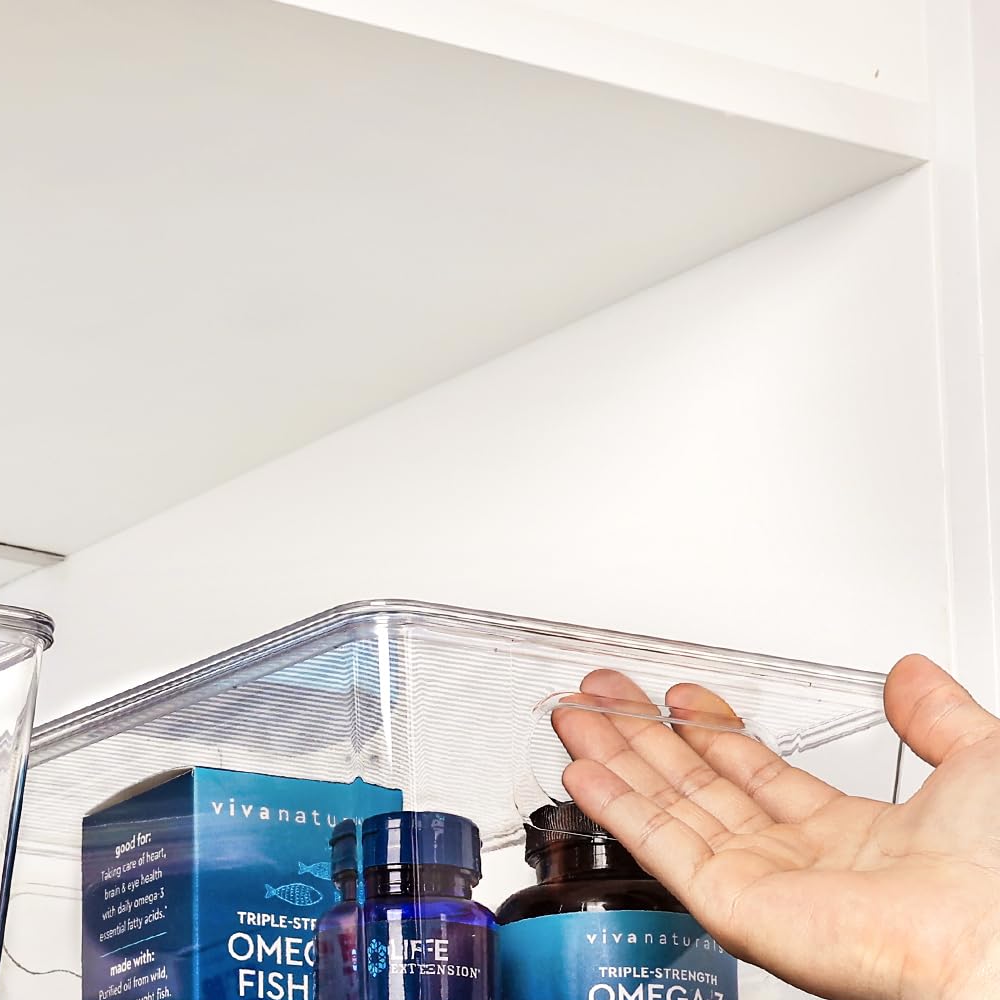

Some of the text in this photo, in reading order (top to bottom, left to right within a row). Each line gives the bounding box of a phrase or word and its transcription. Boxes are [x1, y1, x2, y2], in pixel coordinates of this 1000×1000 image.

[115, 832, 152, 858] good for:
[100, 848, 167, 882] Taking care of heart,
[104, 886, 120, 900] brain
[128, 879, 140, 894] eye
[140, 870, 163, 886] health
[102, 887, 165, 921] with daily omega-3
[100, 914, 143, 942] essential fatty
[110, 950, 154, 977] made with:
[599, 966, 718, 986] TRIPLE-STRENGTH
[124, 978, 132, 990] oil
[133, 974, 149, 988] from
[150, 967, 168, 982] wild,
[157, 986, 172, 999] fish.
